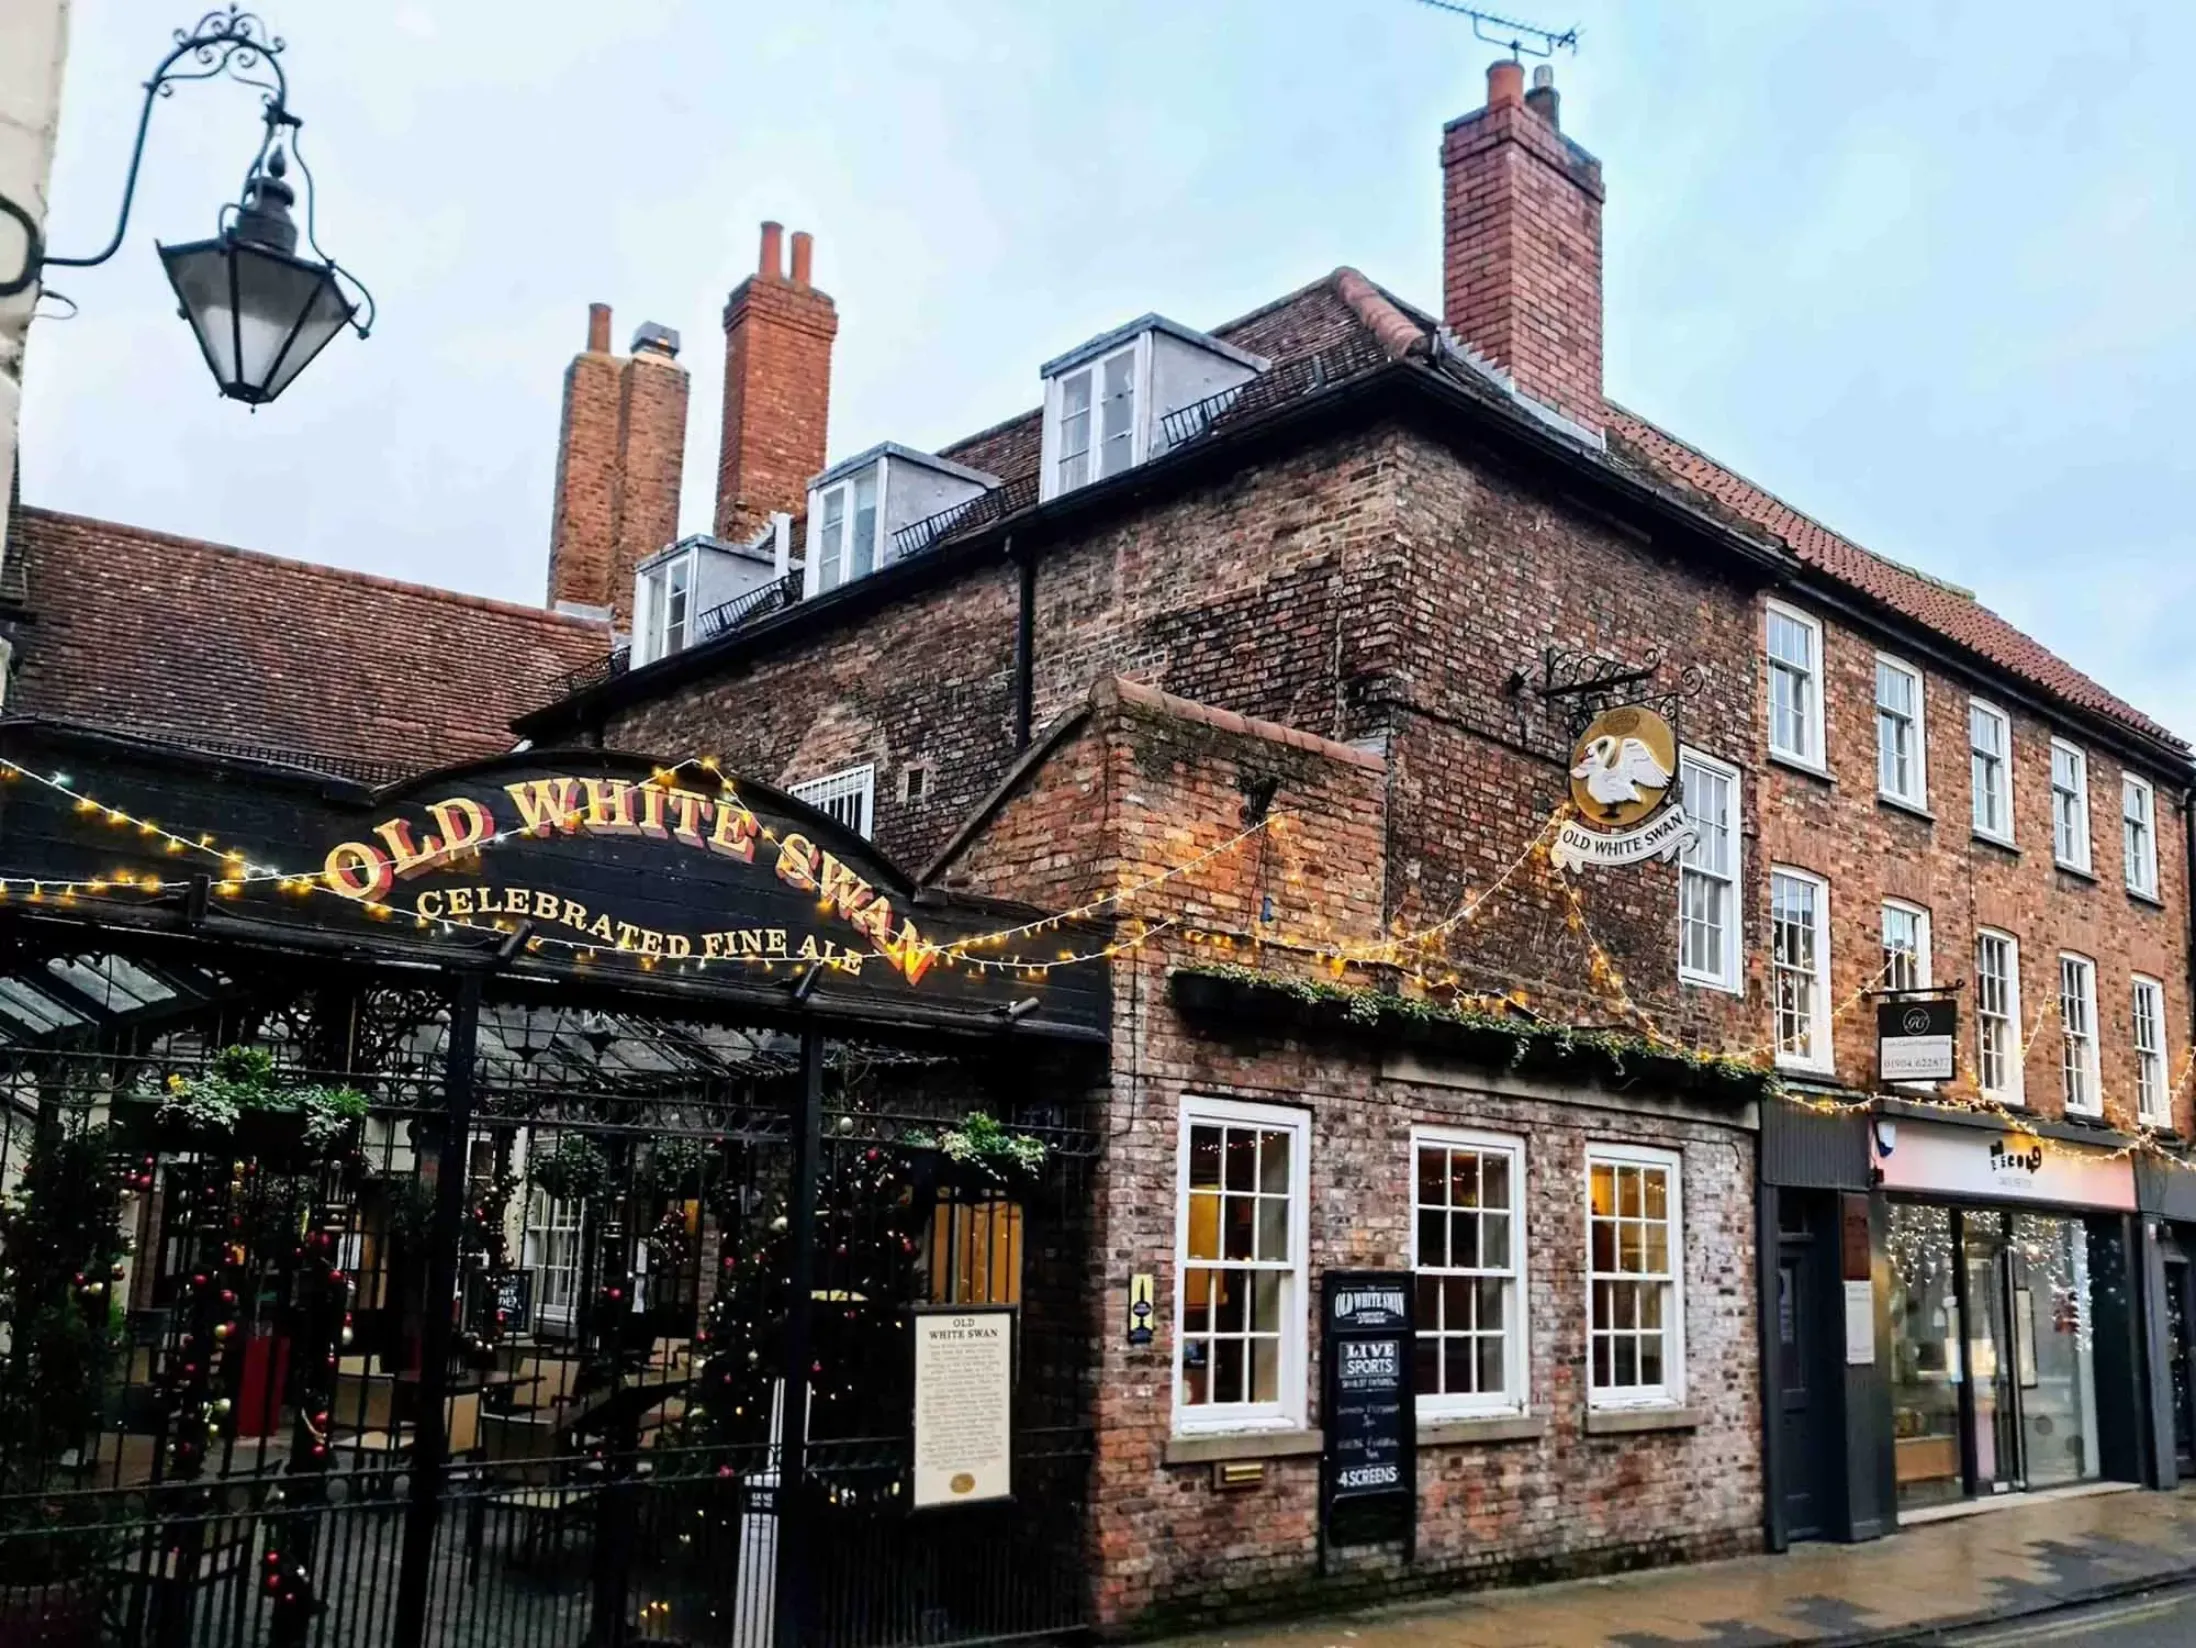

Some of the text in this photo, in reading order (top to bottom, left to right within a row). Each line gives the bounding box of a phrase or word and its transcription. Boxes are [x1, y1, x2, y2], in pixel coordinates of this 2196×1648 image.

[1562, 812, 1682, 857] OLD WHITE SWAN
[325, 777, 935, 986] OLD WHITE SWAN
[416, 888, 863, 976] CELEBRATED FINE ALE
[1335, 1292, 1354, 1318] OLD
[1354, 1292, 1382, 1310] WHITE
[953, 1318, 976, 1328] OLD
[929, 1328, 998, 1340] WHITE SWAN
[1346, 1344, 1395, 1359] LIVE
[1347, 1359, 1394, 1375] SPORTS
[1349, 1466, 1398, 1487] SCREENS
